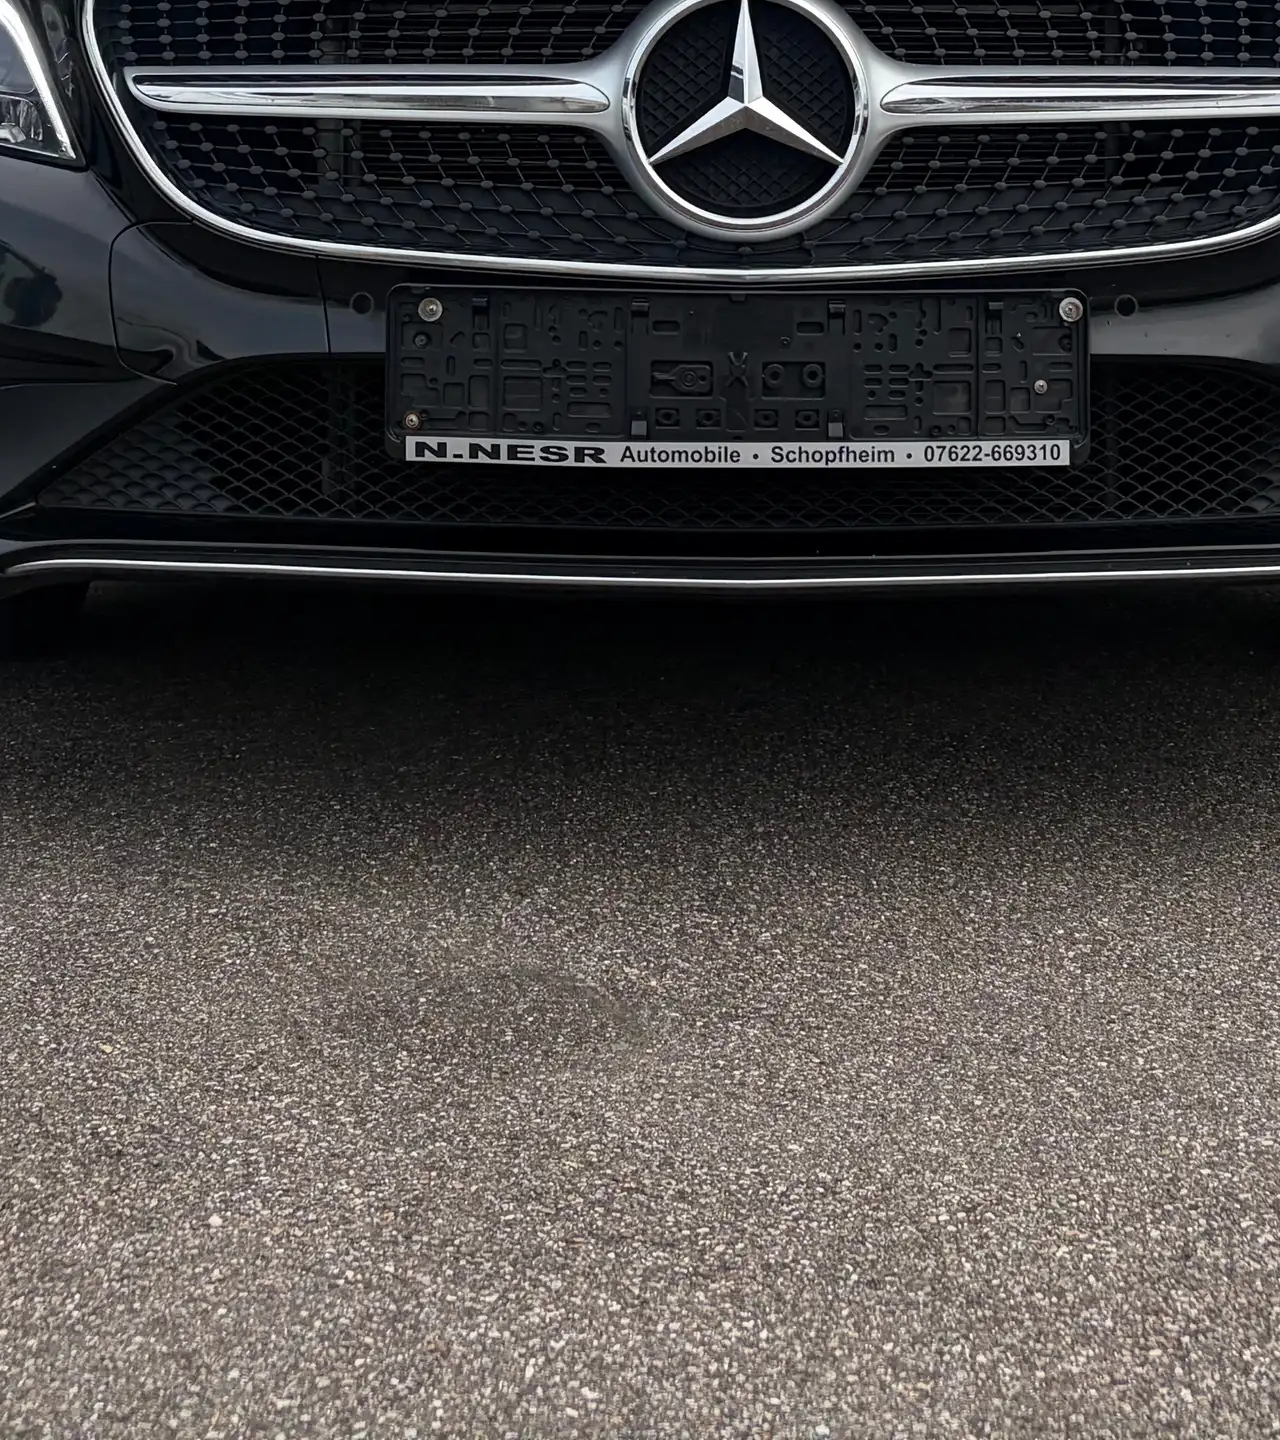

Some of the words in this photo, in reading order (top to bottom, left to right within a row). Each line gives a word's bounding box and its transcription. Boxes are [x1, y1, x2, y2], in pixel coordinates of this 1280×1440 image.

[414, 441, 608, 464] N.NESR
[620, 444, 741, 464] Automobile
[770, 444, 896, 466] Schopfheim
[923, 443, 1062, 463] 07622-669310
